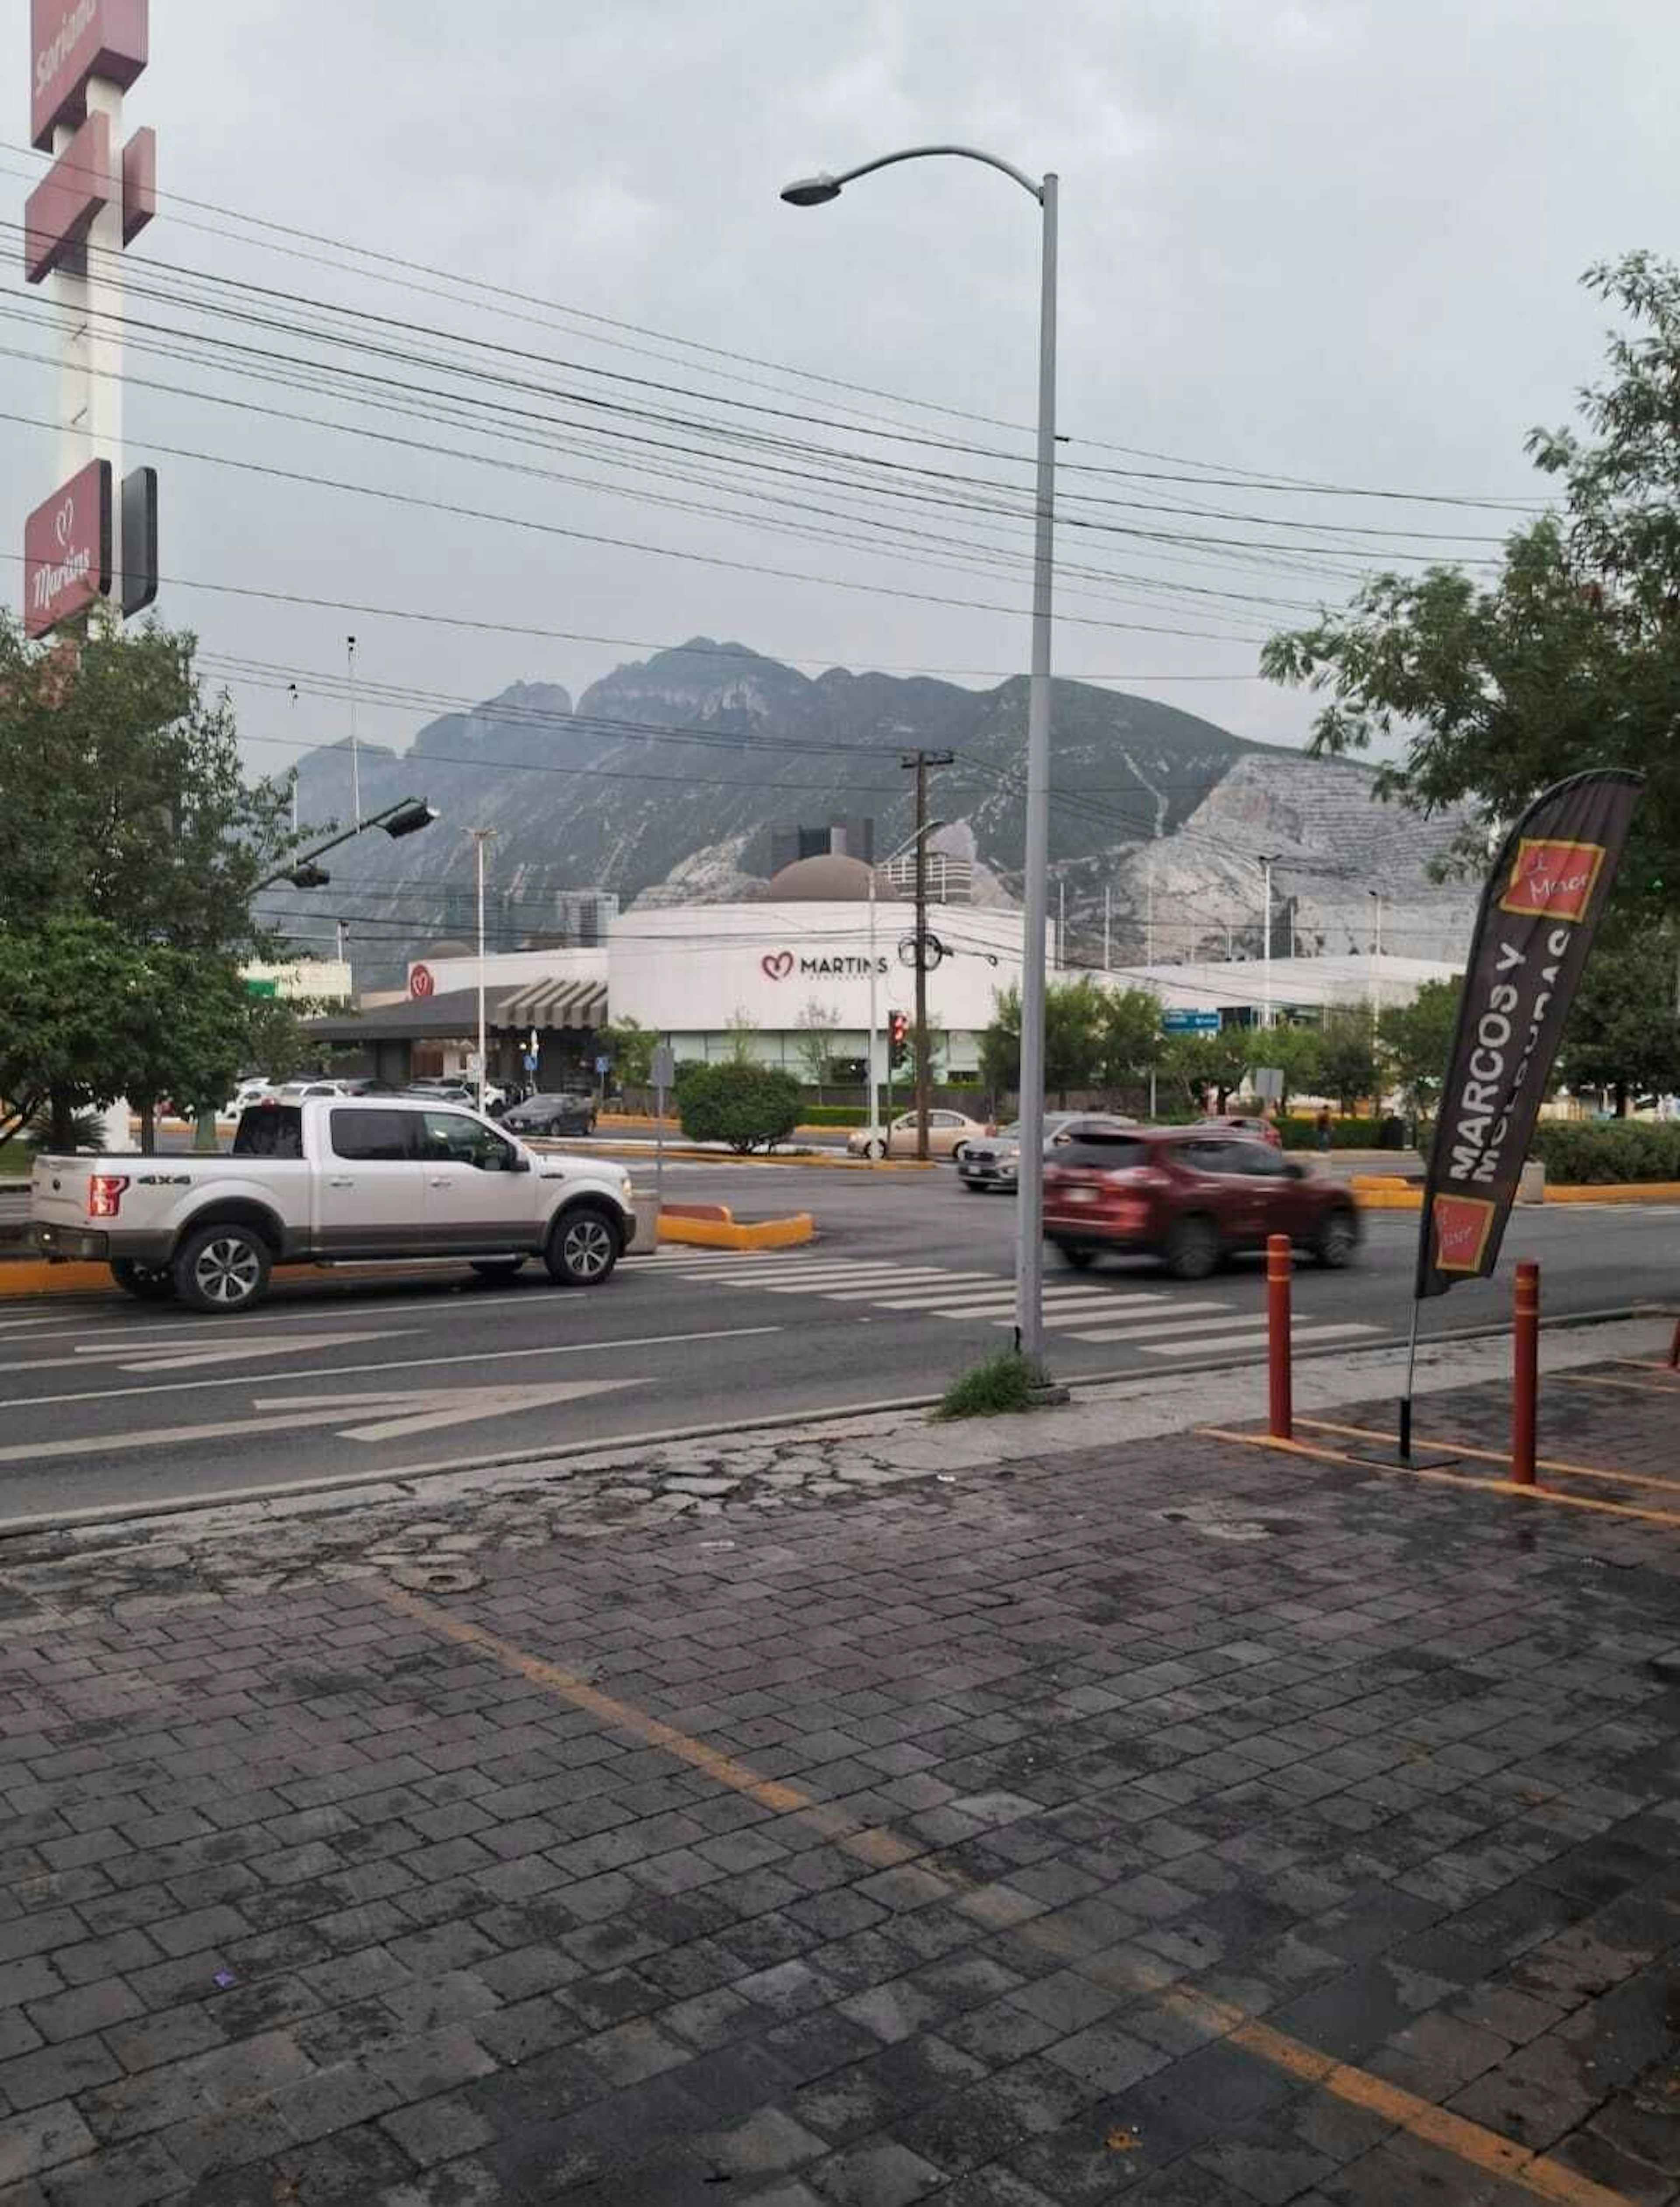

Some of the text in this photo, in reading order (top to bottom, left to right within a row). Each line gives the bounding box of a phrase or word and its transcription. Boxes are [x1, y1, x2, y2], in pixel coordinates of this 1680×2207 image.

[801, 957, 888, 973] MARTINS
[1449, 984, 1518, 1180] MARCOS
[1496, 942, 1526, 971] Y
